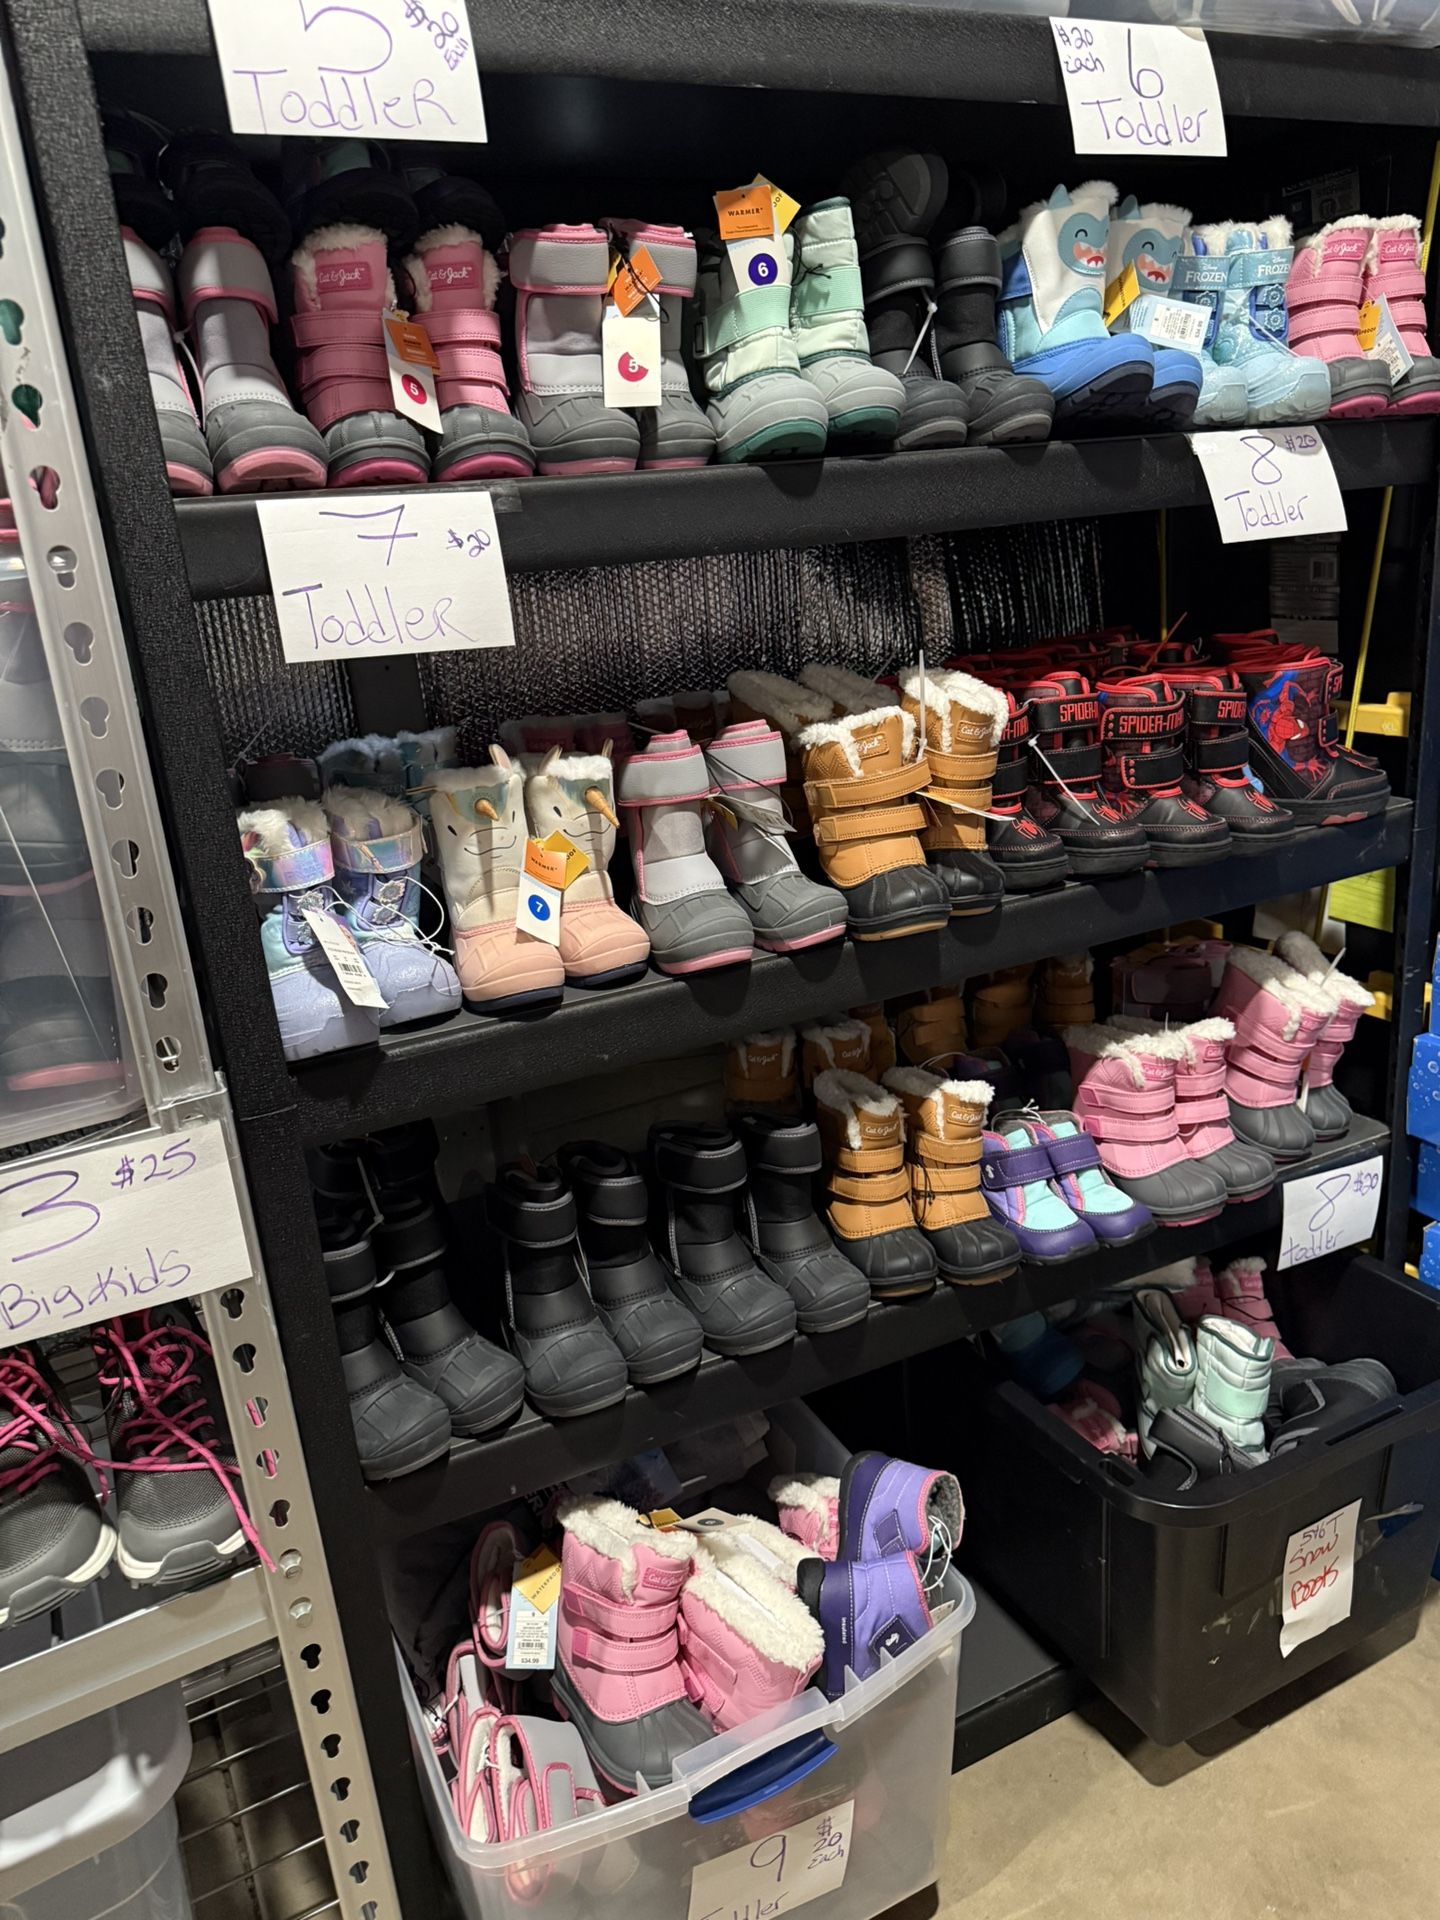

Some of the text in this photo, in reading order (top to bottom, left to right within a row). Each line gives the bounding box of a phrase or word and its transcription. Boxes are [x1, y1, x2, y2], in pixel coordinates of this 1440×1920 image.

[1055, 24, 1164, 99] $20 6
[1081, 97, 1208, 146] Toddler
[758, 262, 769, 277] 6
[1184, 271, 1228, 283] FROZEN
[628, 357, 639, 373] 5
[409, 382, 419, 396] 5
[1240, 435, 1282, 485] 8
[1224, 490, 1308, 532] Toddler
[319, 504, 491, 566] 7 $20
[535, 901, 543, 913] 7
[0, 1138, 196, 1262] 3 $25
[1309, 1171, 1379, 1232] 8 $20
[0, 1284, 84, 1330] Big
[1289, 1533, 1338, 1575] Snow
[750, 1834, 787, 1882] 9
[813, 1831, 843, 1854] 20
